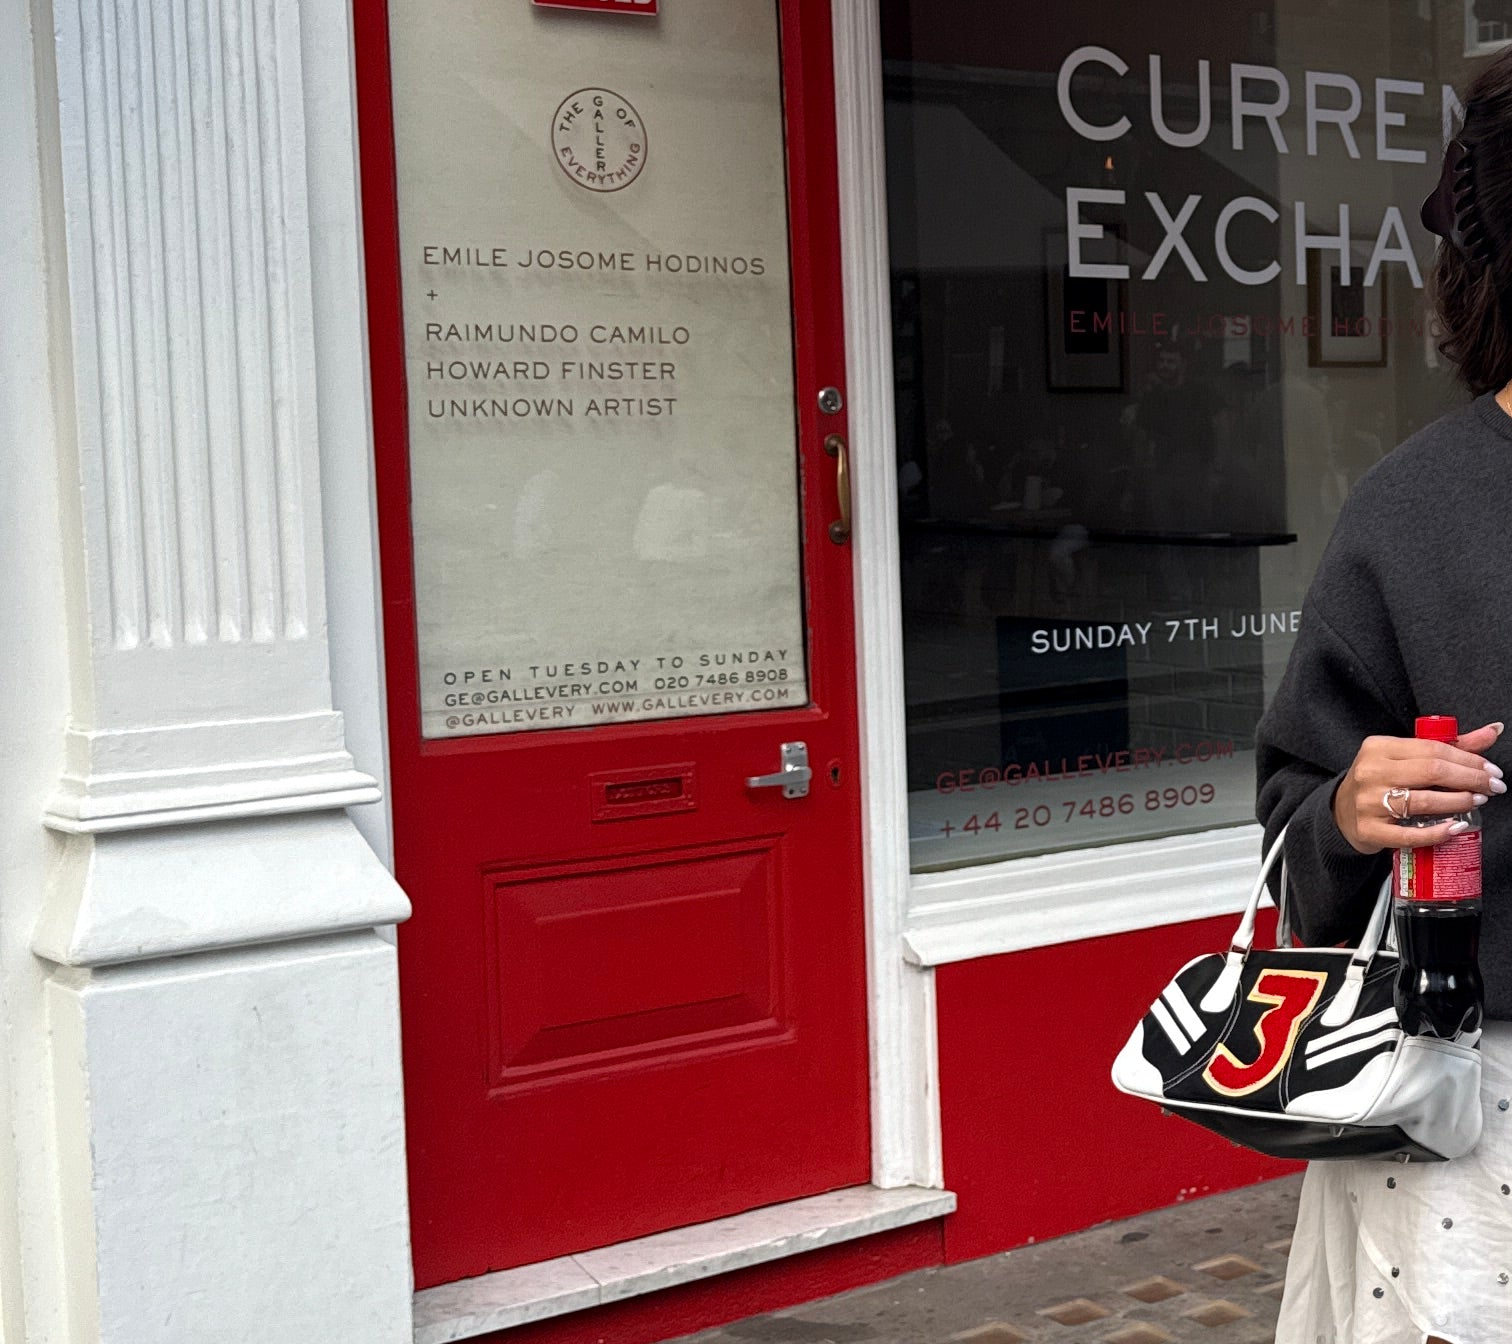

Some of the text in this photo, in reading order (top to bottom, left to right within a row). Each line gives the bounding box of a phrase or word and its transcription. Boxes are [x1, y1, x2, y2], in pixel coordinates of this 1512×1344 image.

[559, 102, 583, 132] THE
[616, 108, 636, 128] OF
[560, 143, 640, 184] EVERYTHING
[1065, 186, 1438, 289] EXCHA
[423, 246, 766, 276] EMILE JOSOME HODINOS
[426, 323, 691, 345] RAIMUNDO CAMILO
[1069, 310, 1169, 336] EMILE
[427, 361, 676, 381] HOWARD FINSTER
[428, 397, 678, 419] UNKNOWN ARTIST
[1031, 611, 1302, 654] SUNDAY 7TH JUNE
[444, 649, 789, 686] OPEN TUESDAY TO SUNDAY
[444, 668, 789, 707] GE@GALLEVERY.COM 020 7486 8908
[446, 688, 790, 730] @GALLEVERY WWW.GALLEVERY.COM
[935, 740, 1235, 796] GE@GALLEVERY.COM
[939, 783, 1216, 838] +44 20 7486 8909
[1202, 968, 1328, 1098] 3
